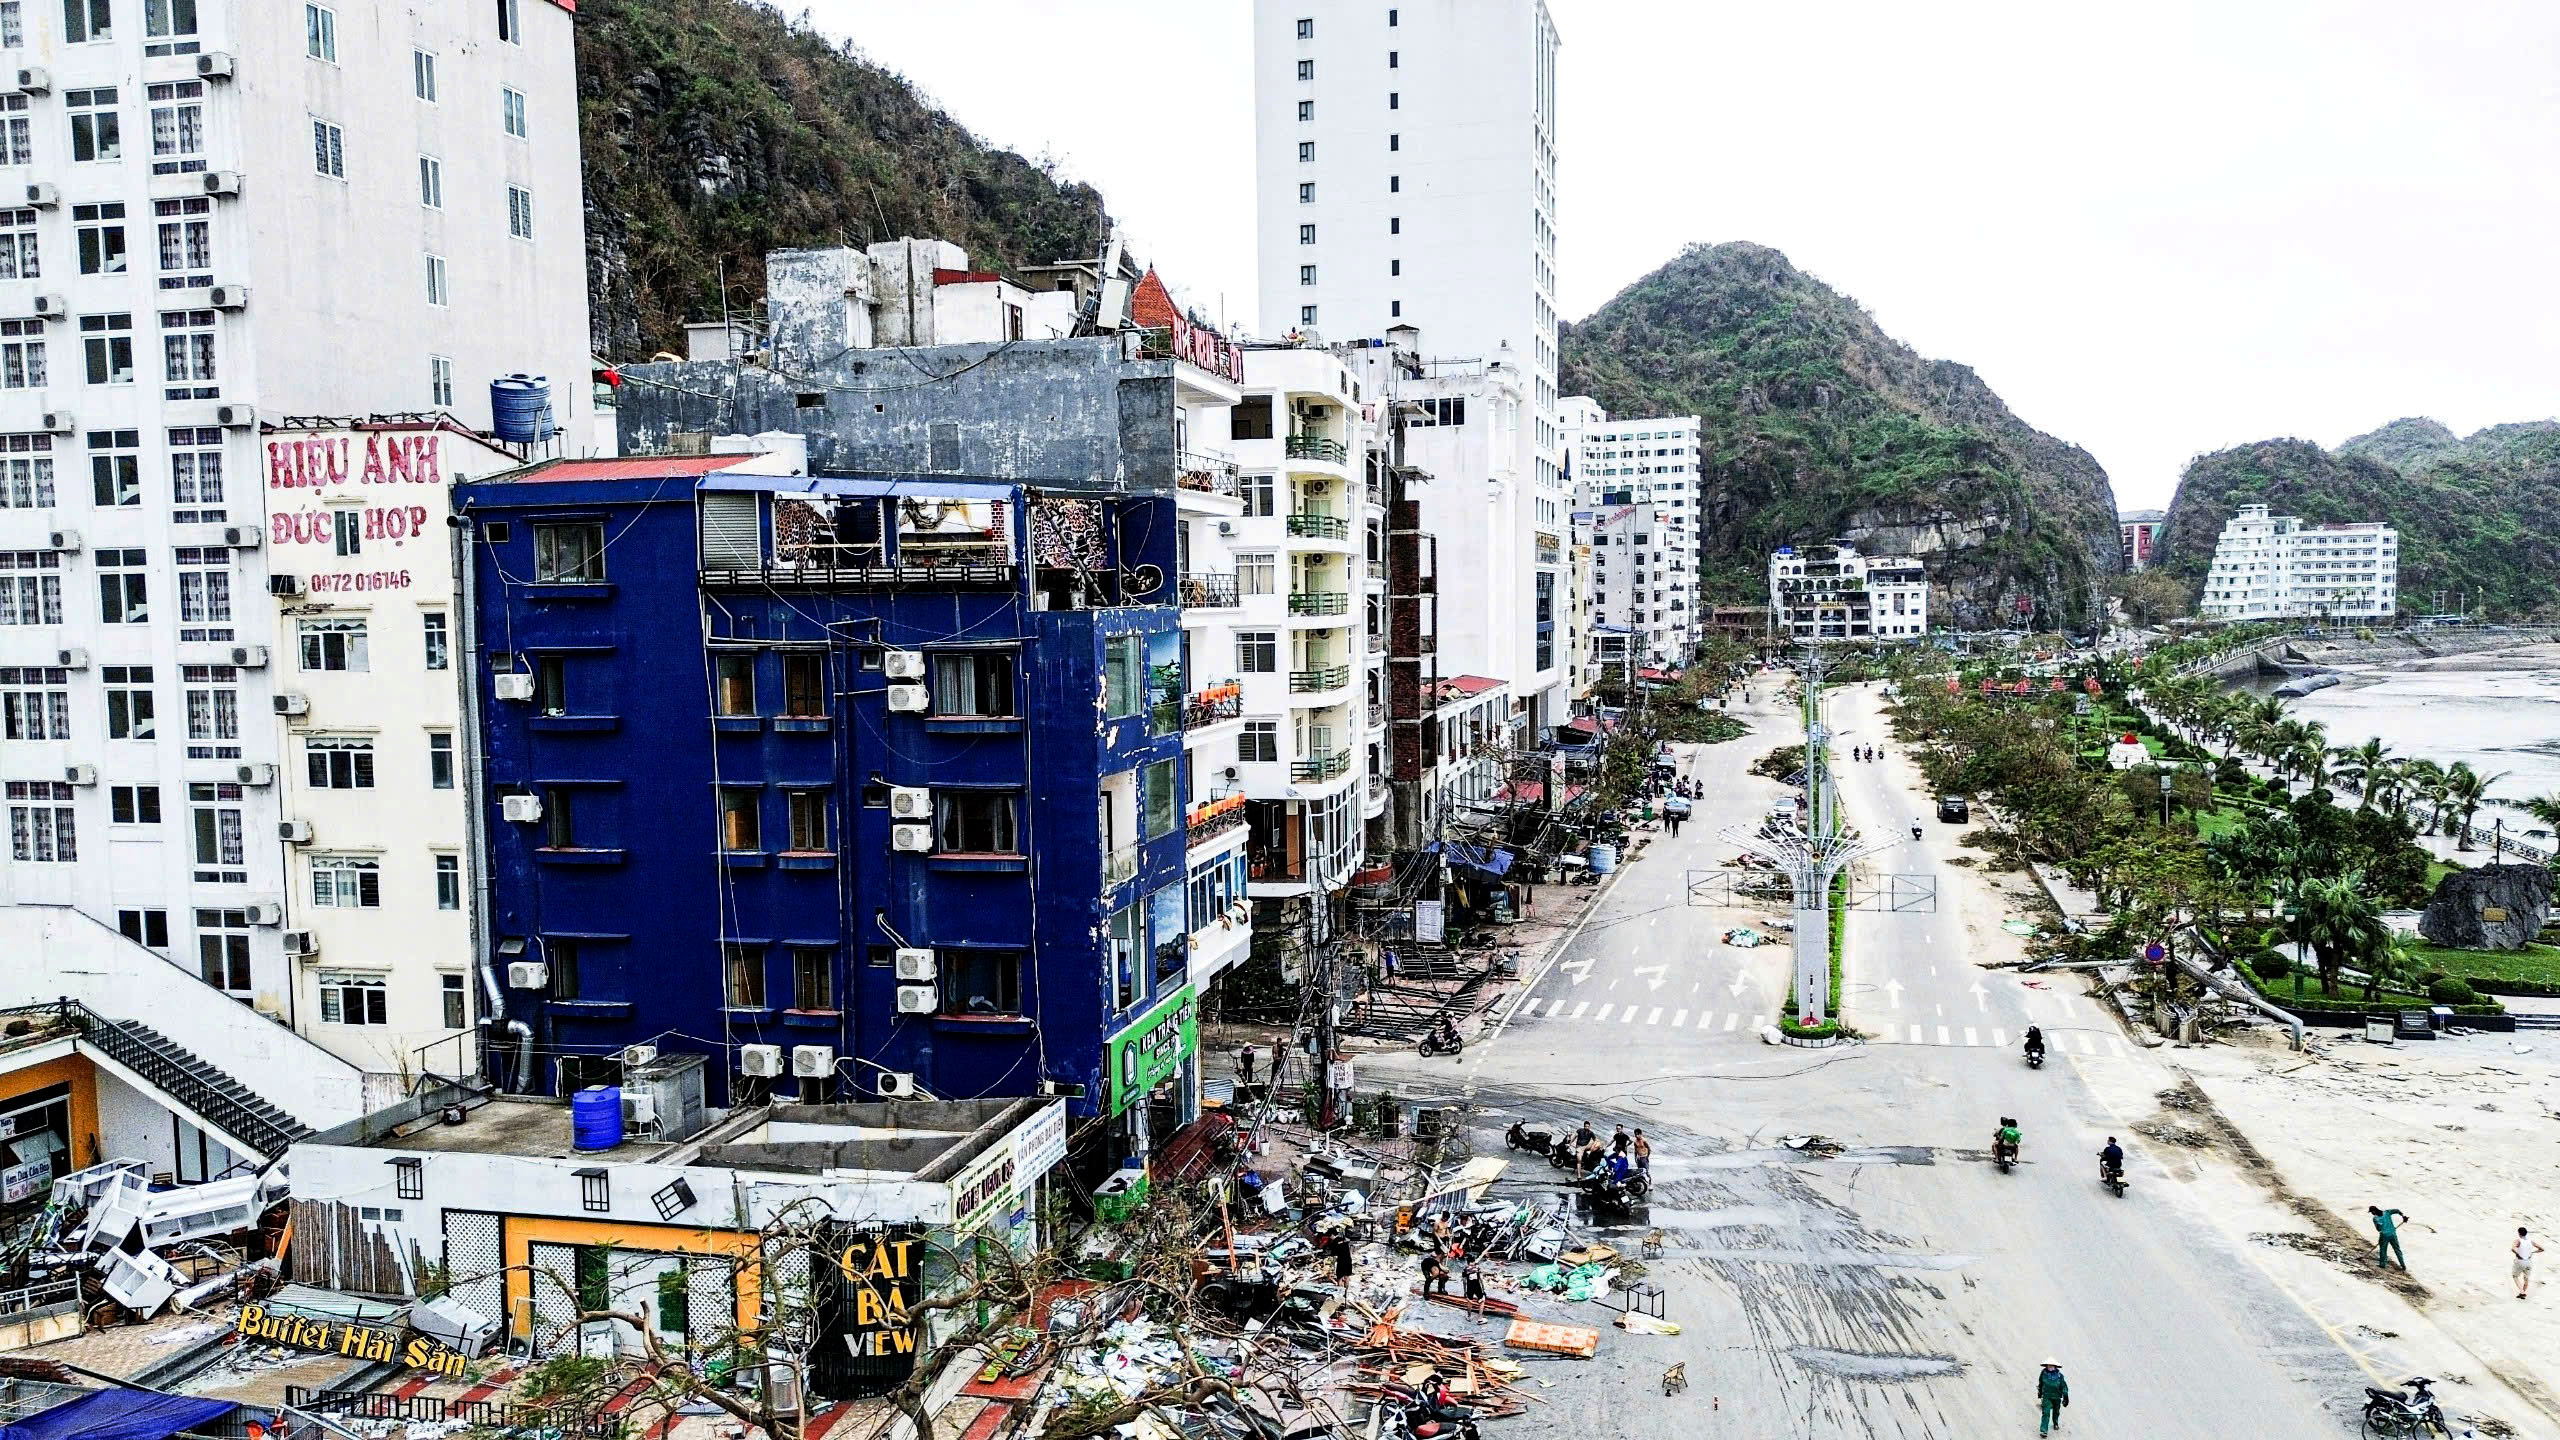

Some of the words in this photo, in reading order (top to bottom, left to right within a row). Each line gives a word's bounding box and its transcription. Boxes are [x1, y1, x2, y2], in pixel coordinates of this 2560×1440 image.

[267, 432, 349, 496] HIỆU
[271, 503, 333, 545] ĐỨC
[364, 505, 427, 547] HỢP
[311, 573, 352, 593] 0972
[355, 569, 411, 592] 016146
[841, 1234, 913, 1282] CÁT
[857, 1280, 909, 1326] BÀ
[237, 1303, 333, 1350] Buffet
[340, 1323, 400, 1364] Hải
[404, 1336, 469, 1377] Sản
[843, 1328, 917, 1357] VIEW
